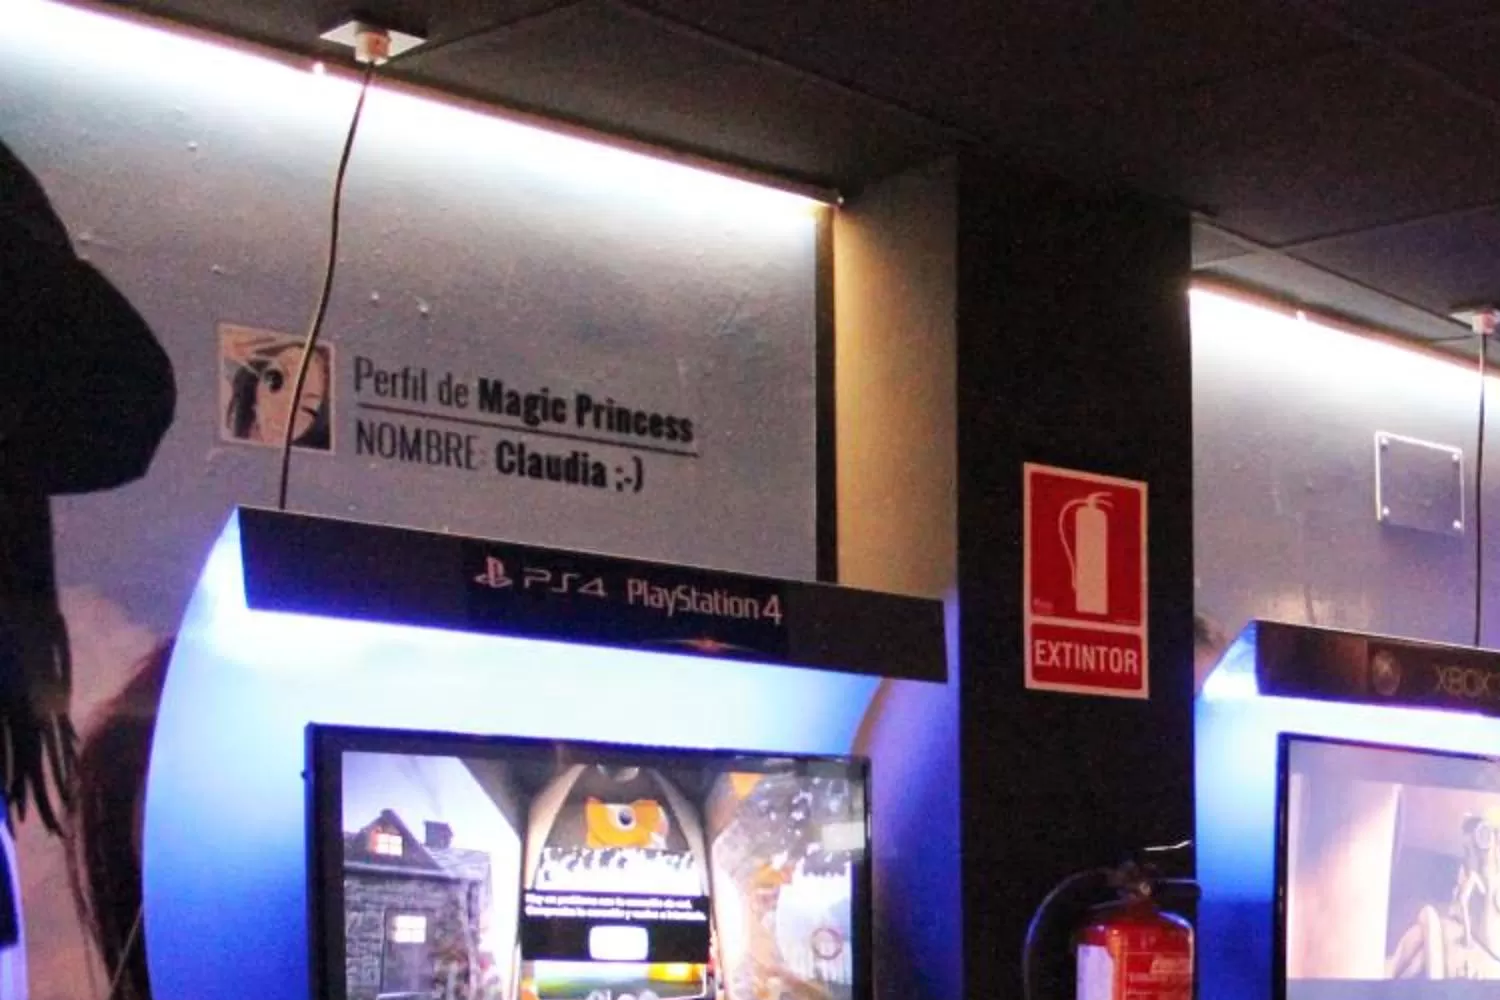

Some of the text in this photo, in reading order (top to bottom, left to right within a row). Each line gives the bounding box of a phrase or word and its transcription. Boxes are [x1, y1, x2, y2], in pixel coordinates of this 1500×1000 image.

[354, 355, 695, 445] Perfil de Magic Princess
[495, 439, 608, 489] Claudia
[523, 566, 607, 597] PS4
[1034, 638, 1138, 676] EXTINTOR
